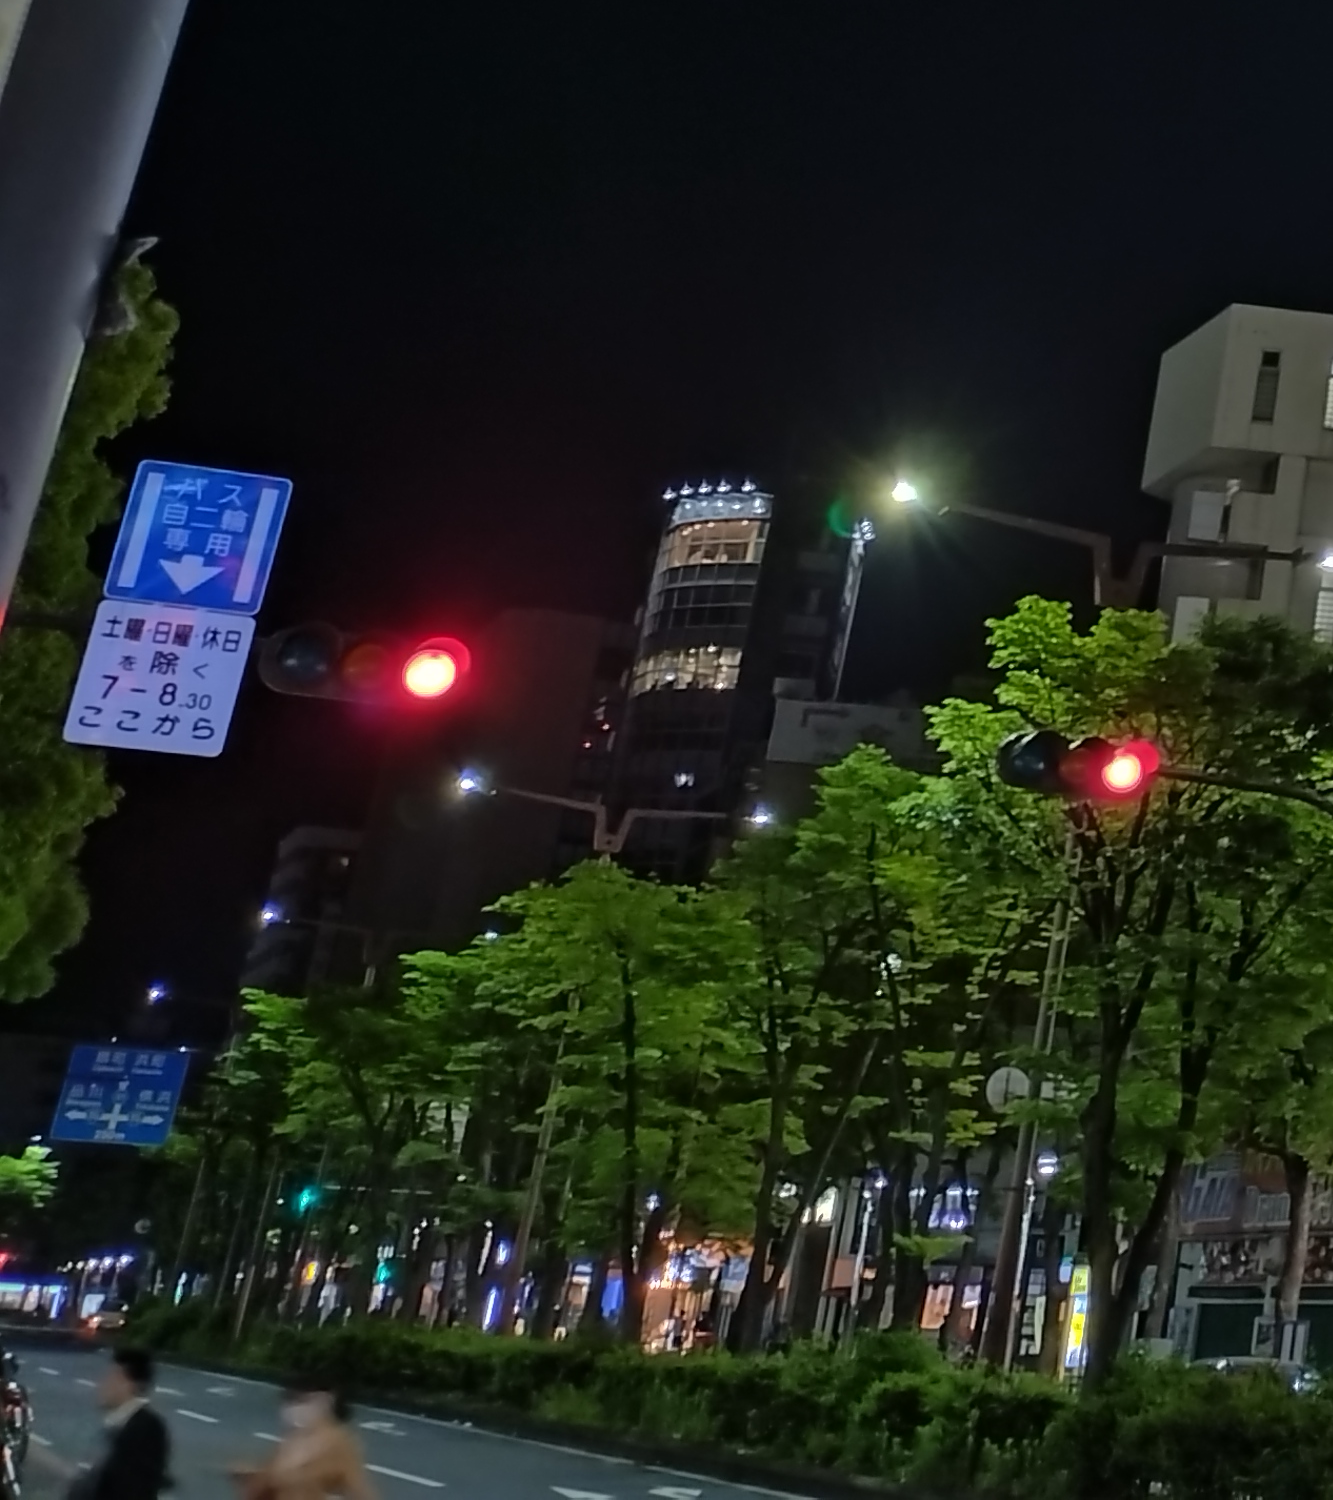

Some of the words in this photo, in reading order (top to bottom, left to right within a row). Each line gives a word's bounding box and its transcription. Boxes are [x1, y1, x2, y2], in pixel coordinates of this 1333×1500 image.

[162, 503, 250, 534] 自二輪
[118, 651, 210, 680] を除く
[78, 705, 216, 741] ここから
